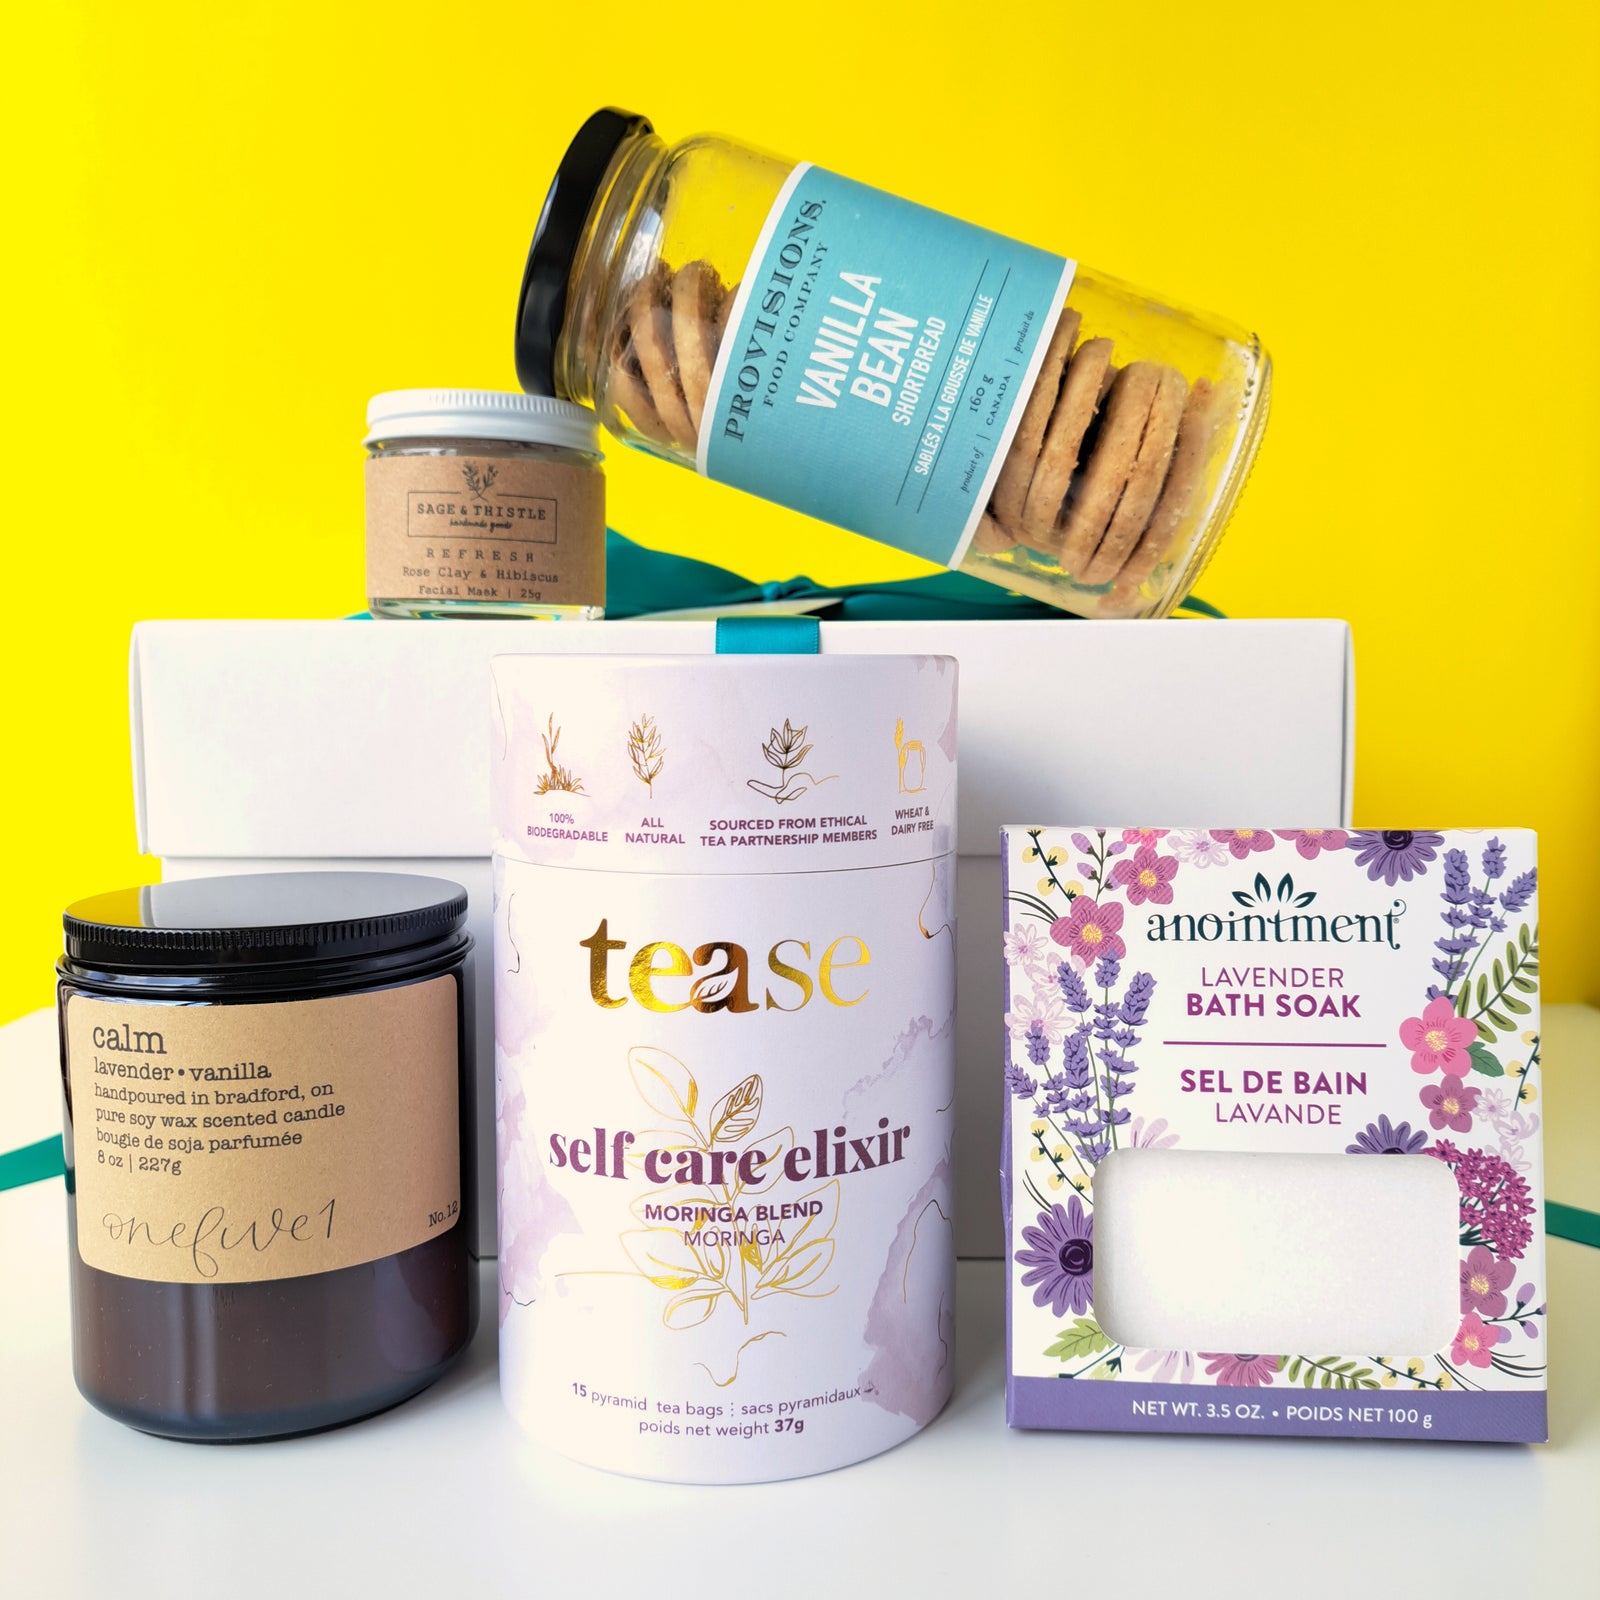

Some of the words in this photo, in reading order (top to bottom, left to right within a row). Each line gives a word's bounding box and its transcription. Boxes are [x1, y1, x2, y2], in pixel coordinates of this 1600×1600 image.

[763, 350, 788, 408] FOOD
[784, 242, 828, 342] COMPANY
[966, 294, 993, 341] VANILLE
[796, 271, 882, 409] VANILLA
[959, 336, 976, 356] DE
[850, 307, 920, 408] BEAN
[892, 317, 946, 426] SHORTBREAD
[941, 355, 970, 404] GOUSSE
[961, 460, 978, 493] product
[973, 446, 984, 459] of
[986, 375, 1010, 426] CANADA
[1014, 321, 1031, 353] produit
[1026, 310, 1034, 321] du
[970, 387, 985, 413] 160
[983, 374, 994, 384] g
[934, 405, 952, 422] LA
[928, 422, 945, 434] À
[915, 432, 940, 476] SABLÉS
[418, 504, 455, 514] SAGE
[460, 506, 467, 515] &
[474, 505, 546, 520] THISTLE
[427, 548, 534, 562] REFRESH
[403, 567, 429, 576] Rose
[439, 568, 471, 580] Clay
[480, 570, 486, 579] &
[497, 569, 559, 582] Hibiscus
[419, 586, 459, 595] Facial
[468, 587, 497, 596] Mask
[520, 588, 541, 599] 25g
[550, 813, 574, 825] 100%
[641, 818, 664, 828] ALL
[709, 819, 774, 831] SOURCED
[779, 818, 816, 829] FROM
[820, 815, 868, 828] ETHICAL
[895, 808, 922, 820] WHEAT
[924, 807, 930, 816] &
[527, 826, 608, 842] BIODEGRADABLE
[625, 833, 685, 845] NATURAL
[700, 835, 726, 847] TEA
[731, 833, 818, 846] PARTNERSHIP
[822, 830, 877, 844] MEMBERS
[891, 823, 916, 836] DAIRY
[918, 820, 934, 832] FREE
[1147, 899, 1406, 950] anointment
[580, 918, 871, 1014] tease
[1202, 967, 1344, 988] LAVENDER
[1187, 993, 1264, 1016] BATH
[1276, 994, 1360, 1017] SOAK
[93, 1024, 167, 1054] calm
[94, 1057, 173, 1081] lavender
[189, 1063, 271, 1081] vanilla
[1181, 1069, 1232, 1093] SEL
[1243, 1071, 1282, 1093] DE
[1294, 1072, 1366, 1095] BAIN
[95, 1083, 185, 1106] handpoured
[191, 1092, 209, 1105] in
[215, 1086, 305, 1105] bradford,
[311, 1083, 334, 1096] on
[96, 1106, 125, 1125] pure
[130, 1114, 156, 1129] soy
[161, 1115, 198, 1128] wax
[203, 1110, 278, 1128] scented
[283, 1102, 345, 1122] candle
[1216, 1103, 1341, 1124] LAVANDE
[97, 1128, 140, 1150] bougie
[144, 1135, 163, 1150] de
[168, 1137, 204, 1154] soja
[209, 1131, 302, 1153] parfumée
[550, 1128, 635, 1180] self
[644, 1149, 766, 1185] care
[784, 1118, 911, 1182] elixir
[98, 1151, 105, 1164] 8
[109, 1156, 123, 1168] oz
[139, 1157, 181, 1175] 227g
[428, 1202, 458, 1228] No.12
[645, 1204, 748, 1222] MORINGA
[756, 1201, 823, 1221] BLEND
[684, 1230, 785, 1247] MORINGA
[572, 1382, 587, 1397] 15
[591, 1390, 647, 1411] pyramid
[657, 1401, 681, 1414] tea
[686, 1401, 723, 1419] bags
[742, 1402, 773, 1415] sacs
[779, 1387, 861, 1415] pyramidaux
[1132, 1400, 1168, 1416] NET
[1171, 1401, 1201, 1417] WT.
[1206, 1402, 1230, 1418] 3.5
[1235, 1403, 1265, 1419] OZ.
[1286, 1405, 1342, 1422] POIDS
[1348, 1407, 1383, 1423] NET
[1388, 1408, 1418, 1423] 100
[1423, 1411, 1432, 1428] g
[639, 1419, 680, 1436] poids
[685, 1422, 710, 1436] net
[716, 1420, 769, 1438] weight
[775, 1418, 804, 1433] 37g
